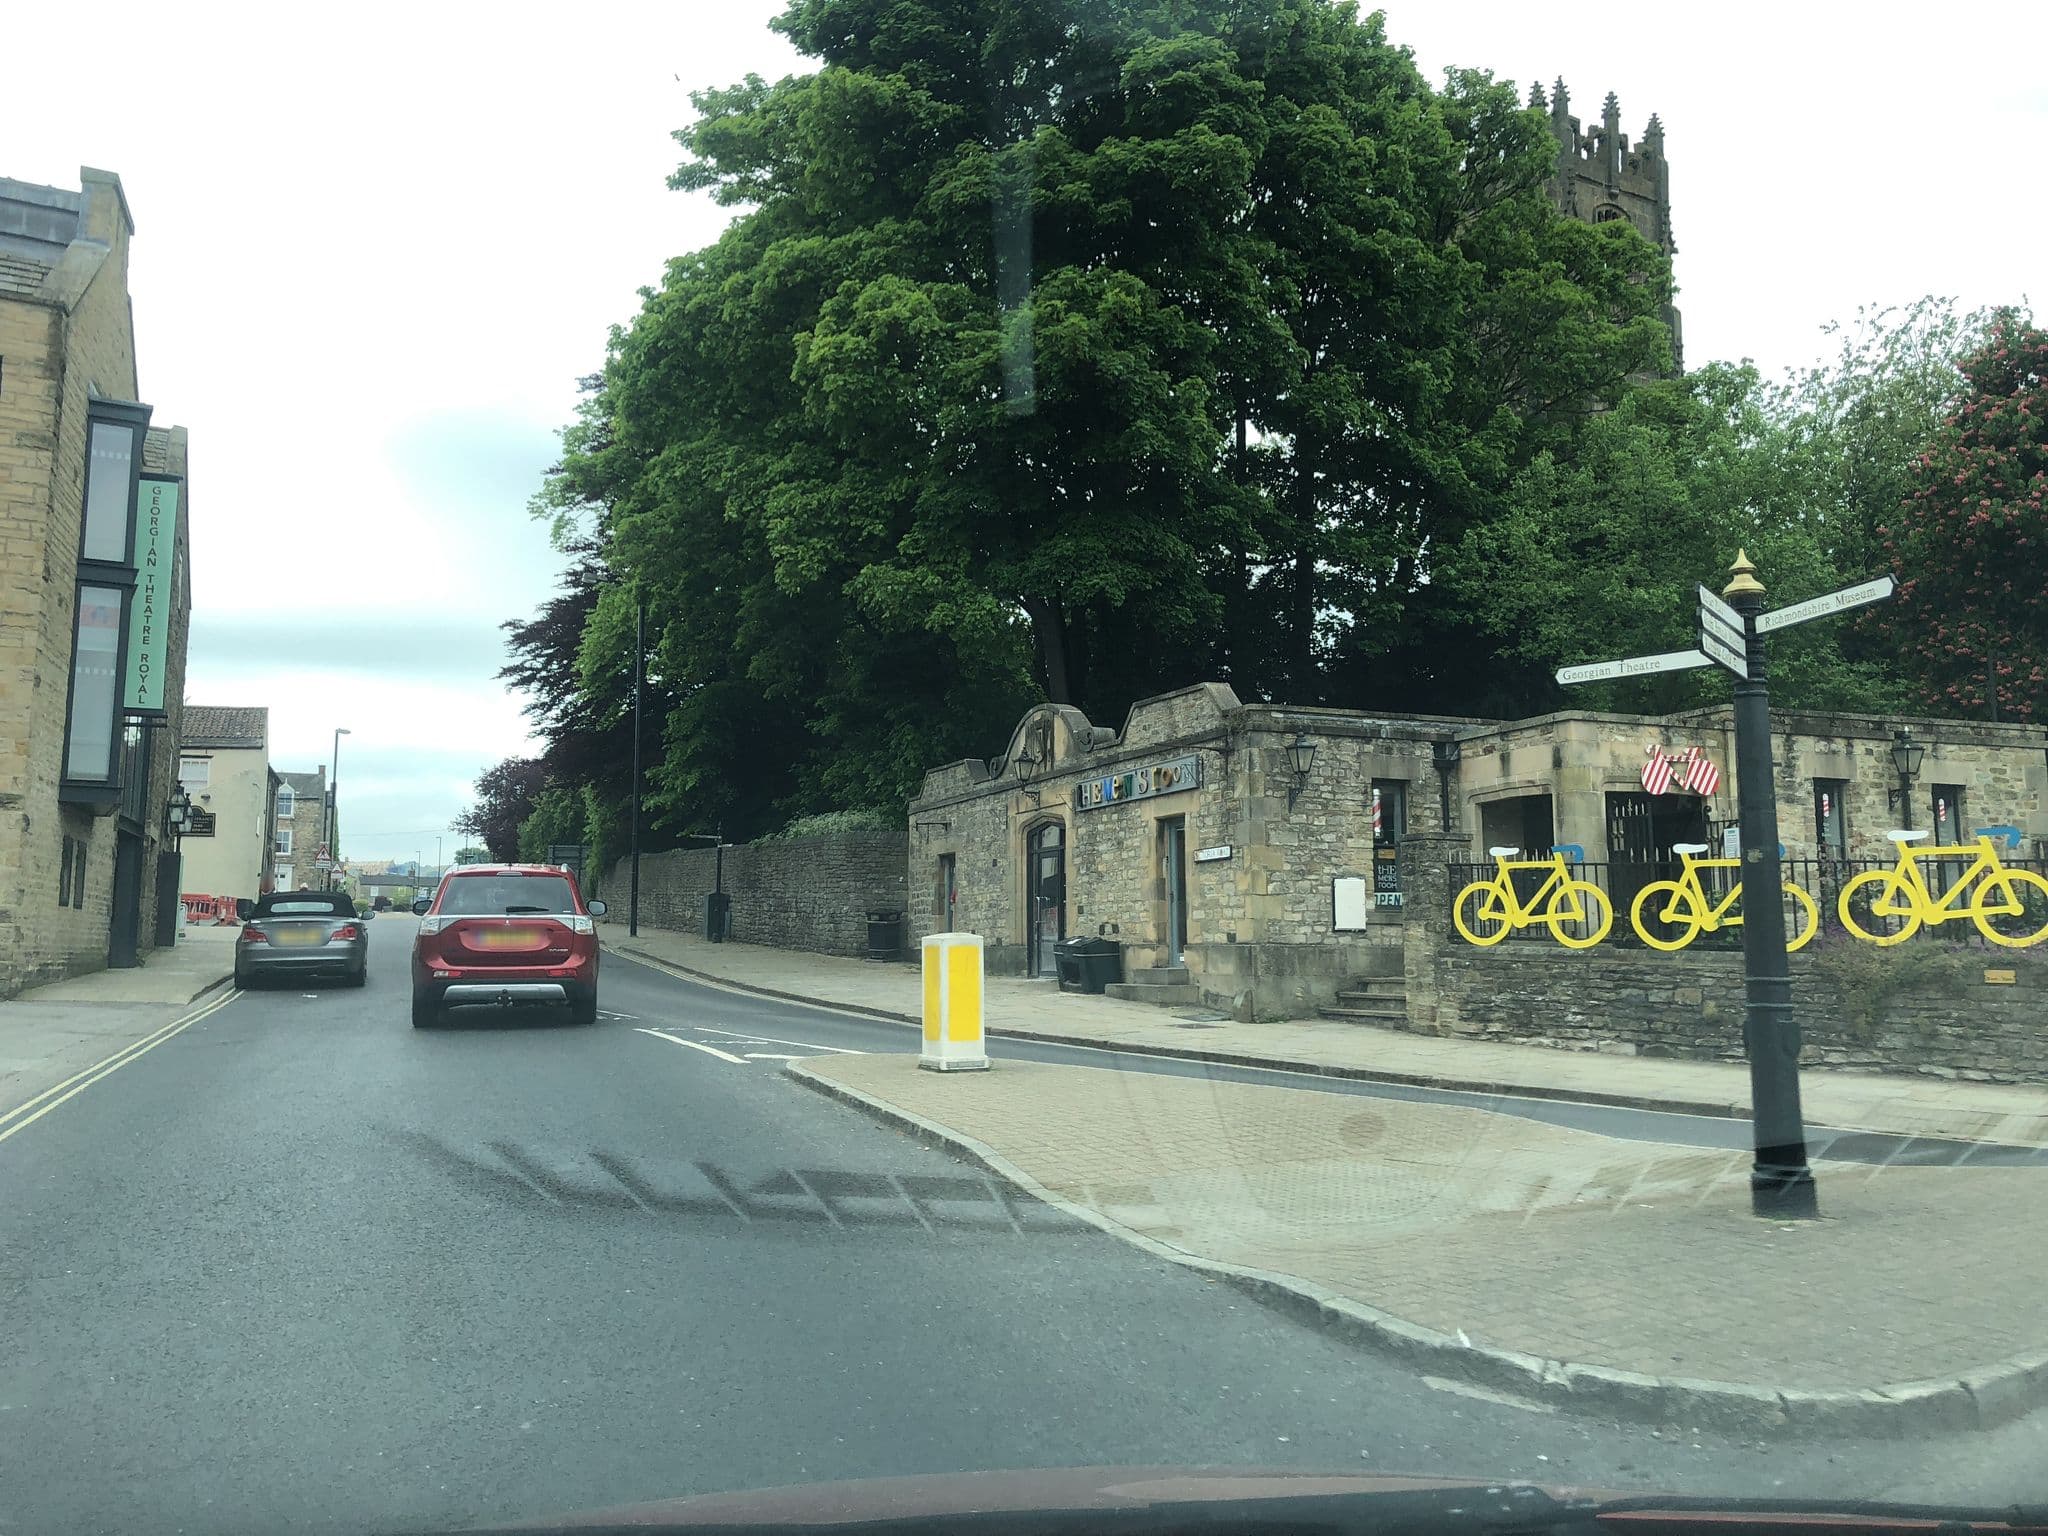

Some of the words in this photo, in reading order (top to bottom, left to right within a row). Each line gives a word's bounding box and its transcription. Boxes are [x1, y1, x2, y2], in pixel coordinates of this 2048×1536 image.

[147, 486, 162, 567] GEORGIAN
[142, 574, 155, 645] THEATRE
[1765, 601, 1830, 628] Richmondshire
[1835, 587, 1877, 607] Museum
[138, 653, 150, 704] ROYAL
[1563, 666, 1611, 681] Georgian
[1618, 660, 1661, 673] Theatre
